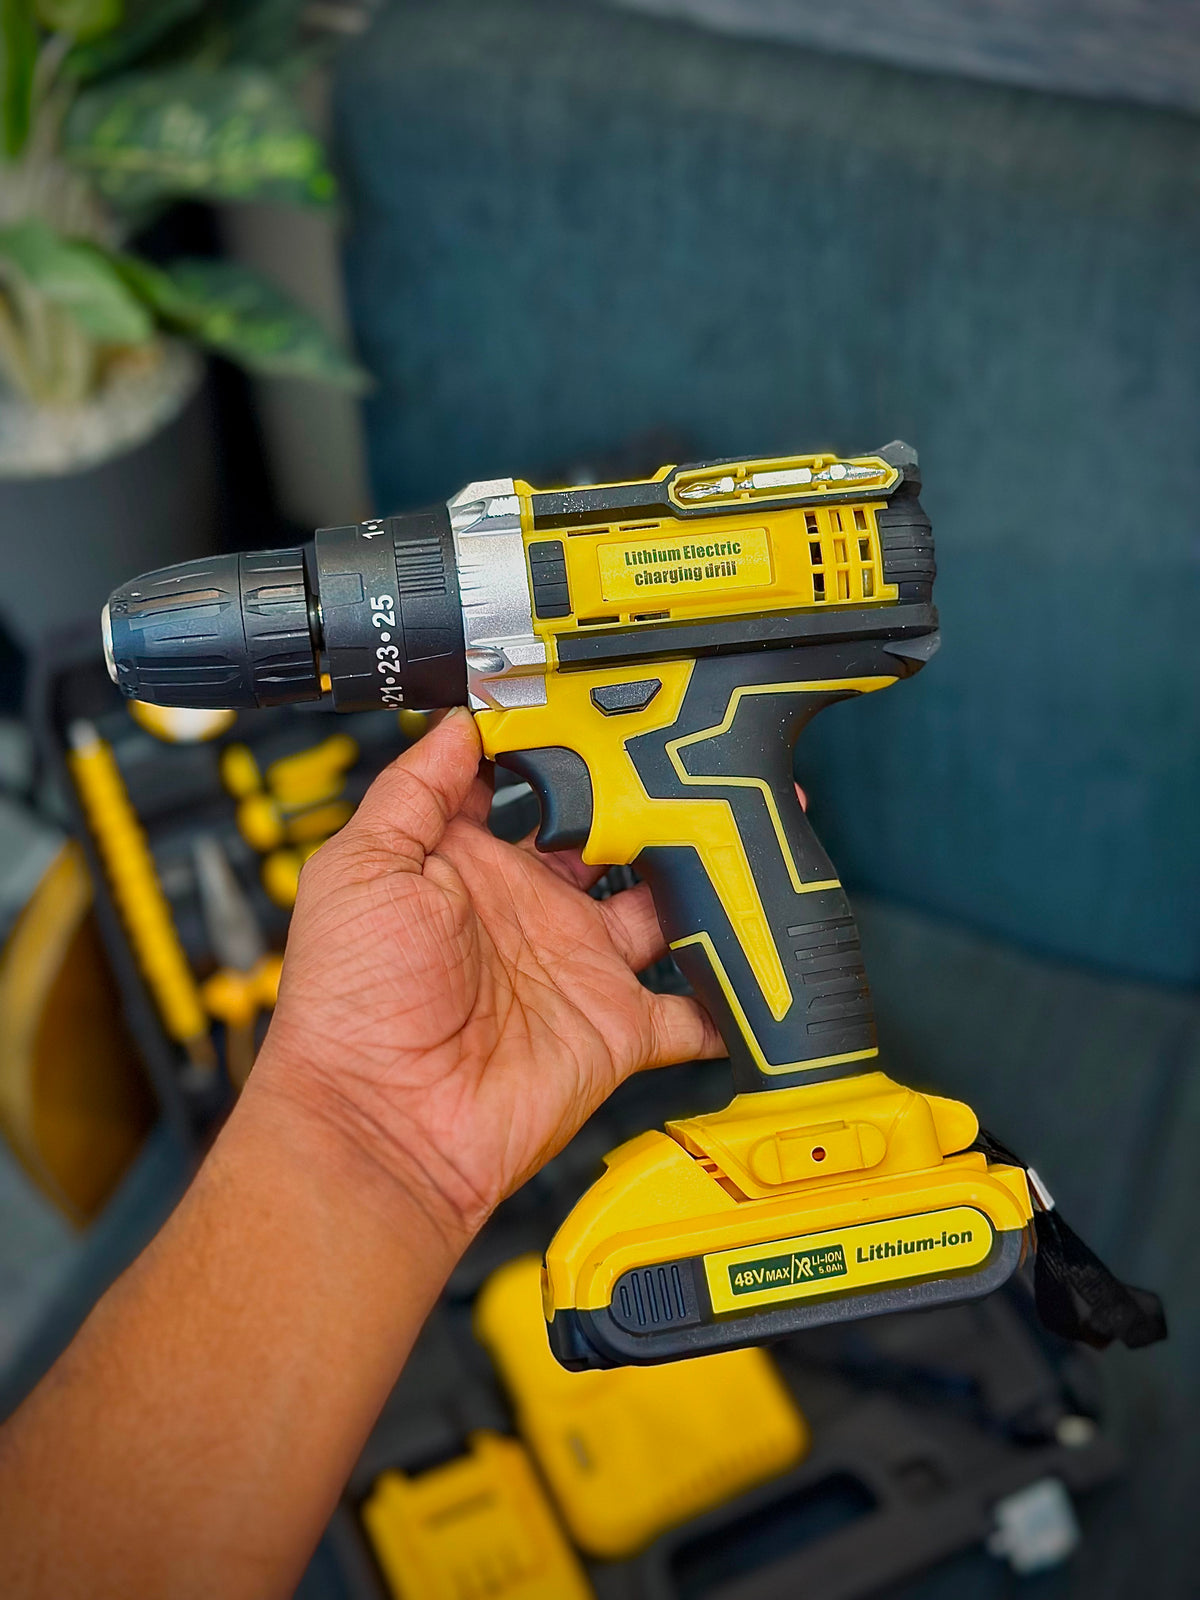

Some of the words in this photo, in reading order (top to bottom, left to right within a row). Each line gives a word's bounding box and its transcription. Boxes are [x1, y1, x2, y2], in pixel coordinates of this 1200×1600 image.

[625, 549, 682, 565] Lithium
[683, 541, 741, 559] Electric
[635, 566, 703, 586] charging
[705, 561, 737, 578] drill
[370, 594, 396, 628] 25
[376, 645, 401, 674] 23
[812, 1250, 842, 1266] LI-ION
[856, 1229, 972, 1263] Lithium-ion
